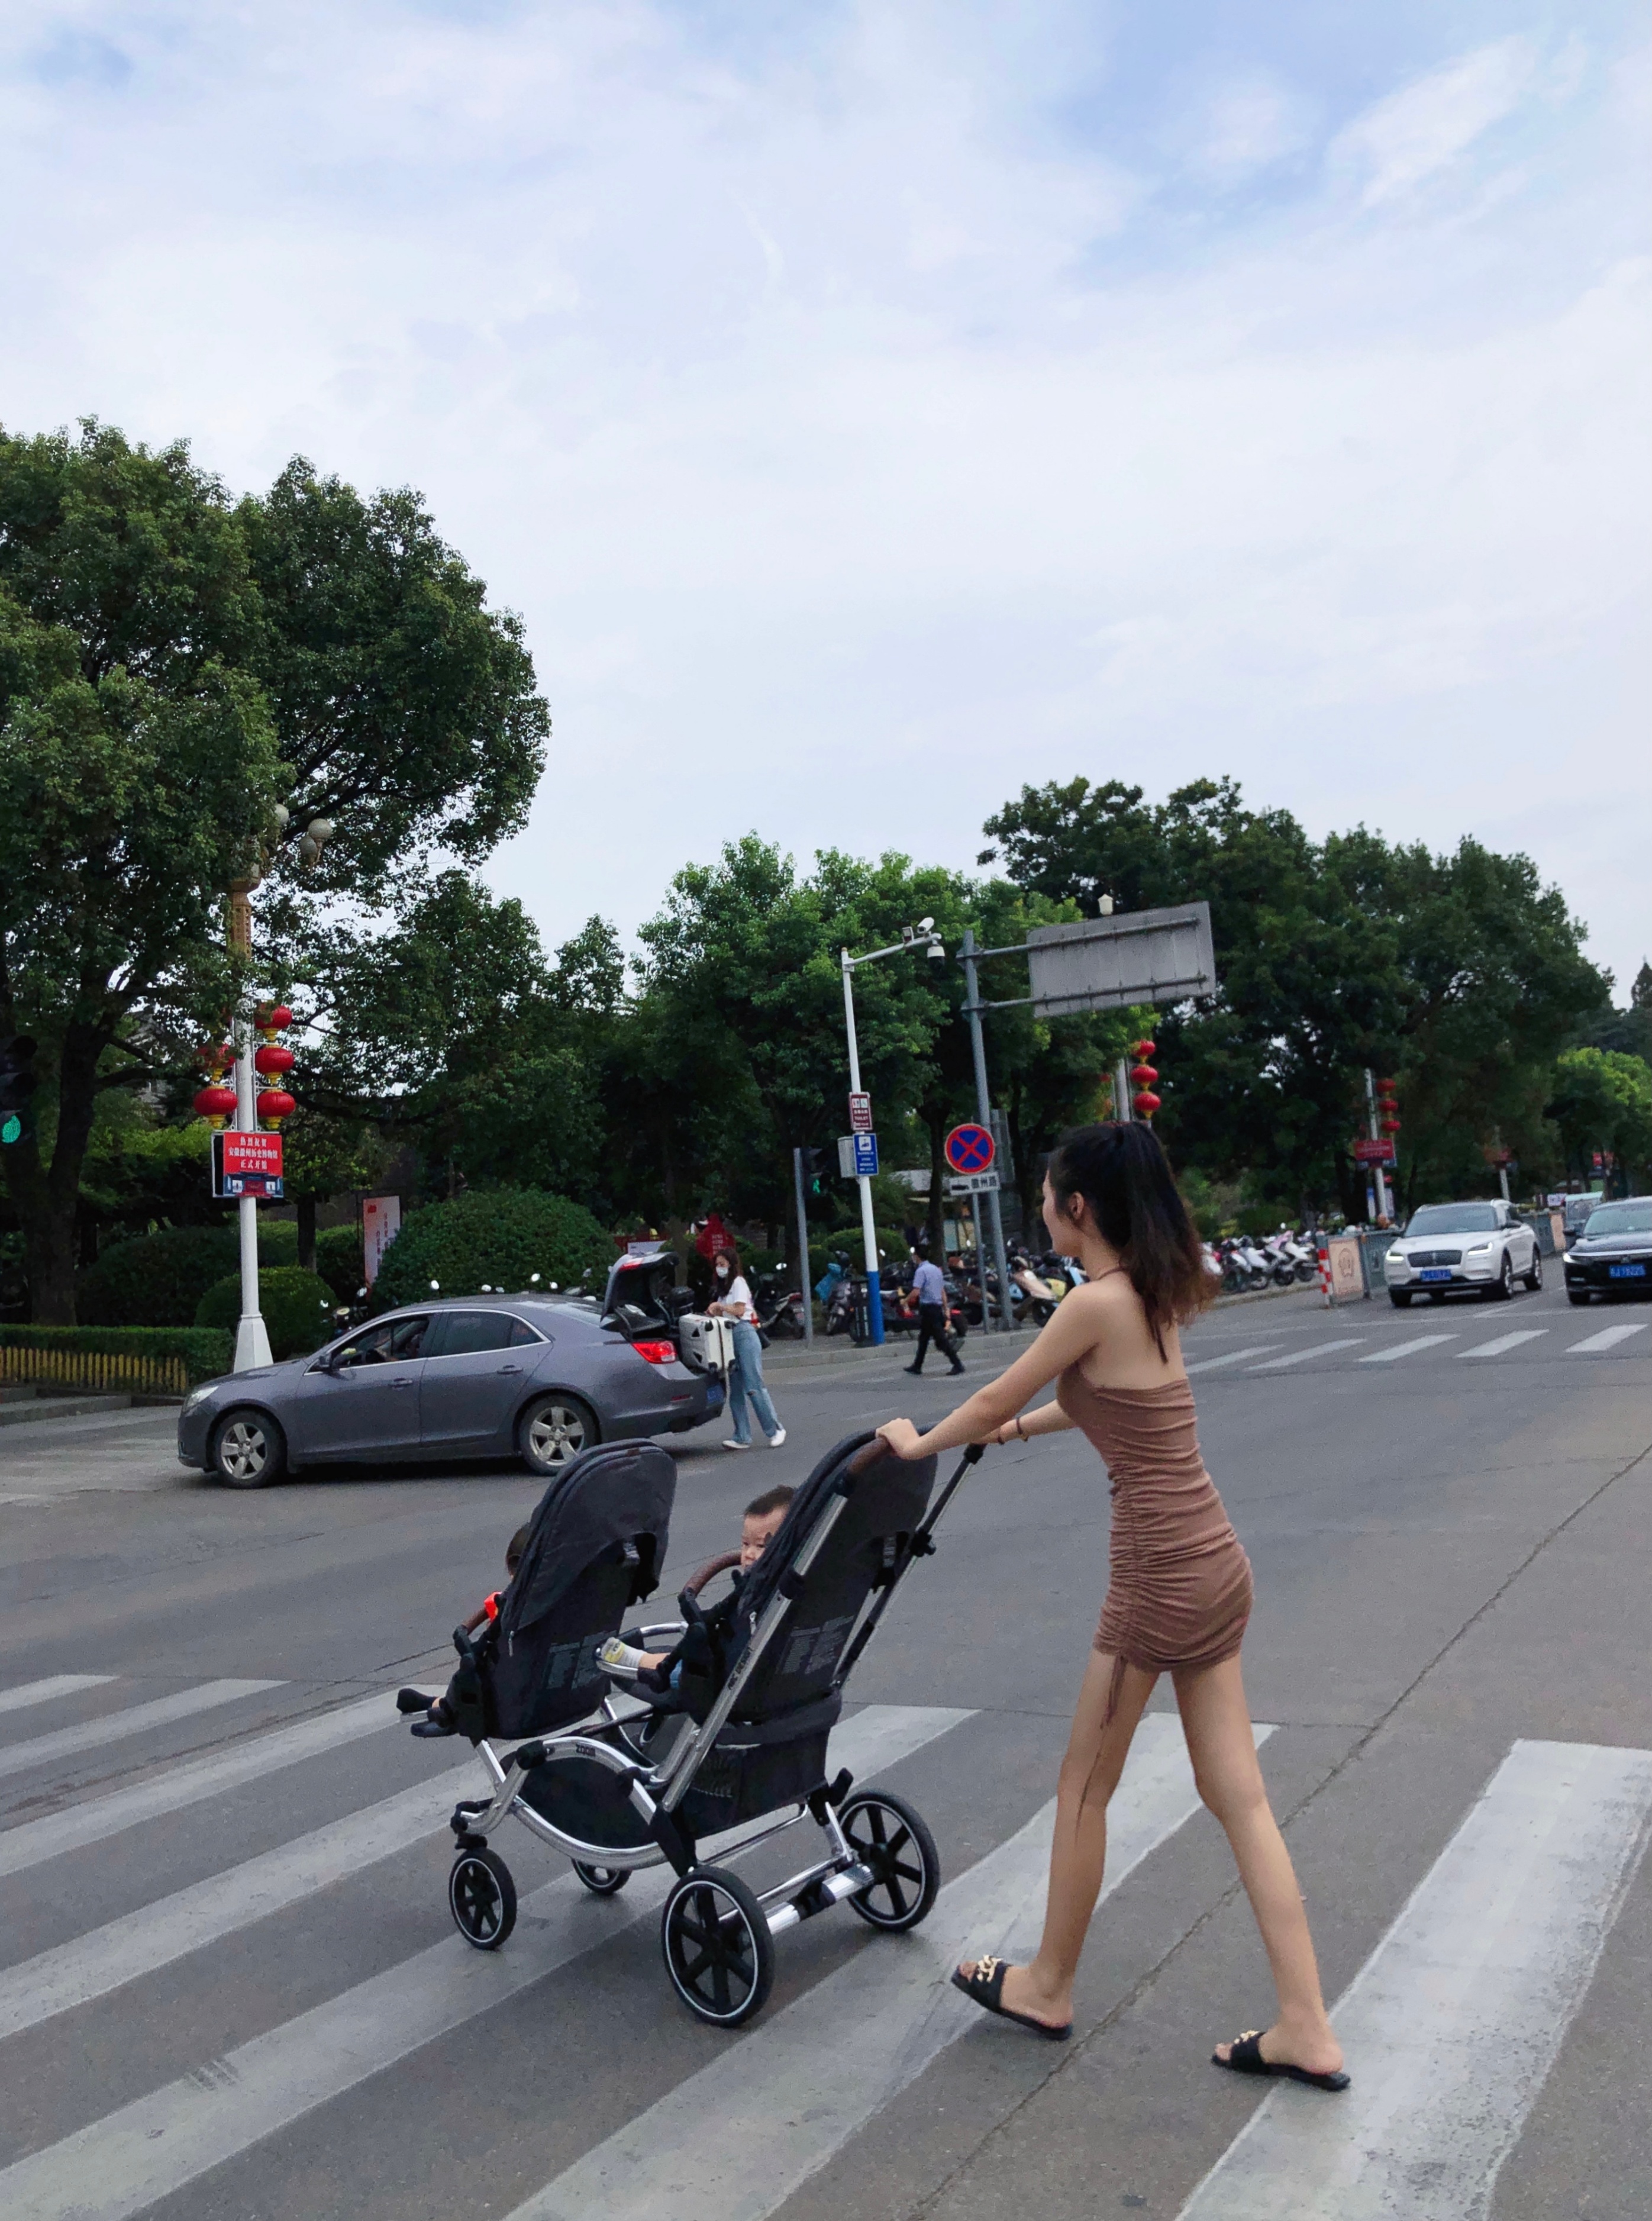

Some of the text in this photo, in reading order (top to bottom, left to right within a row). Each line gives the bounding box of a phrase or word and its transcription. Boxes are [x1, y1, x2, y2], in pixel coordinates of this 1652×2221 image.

[241, 1136, 267, 1147] 热烈祝贺
[241, 1159, 267, 1169] 正式开馆
